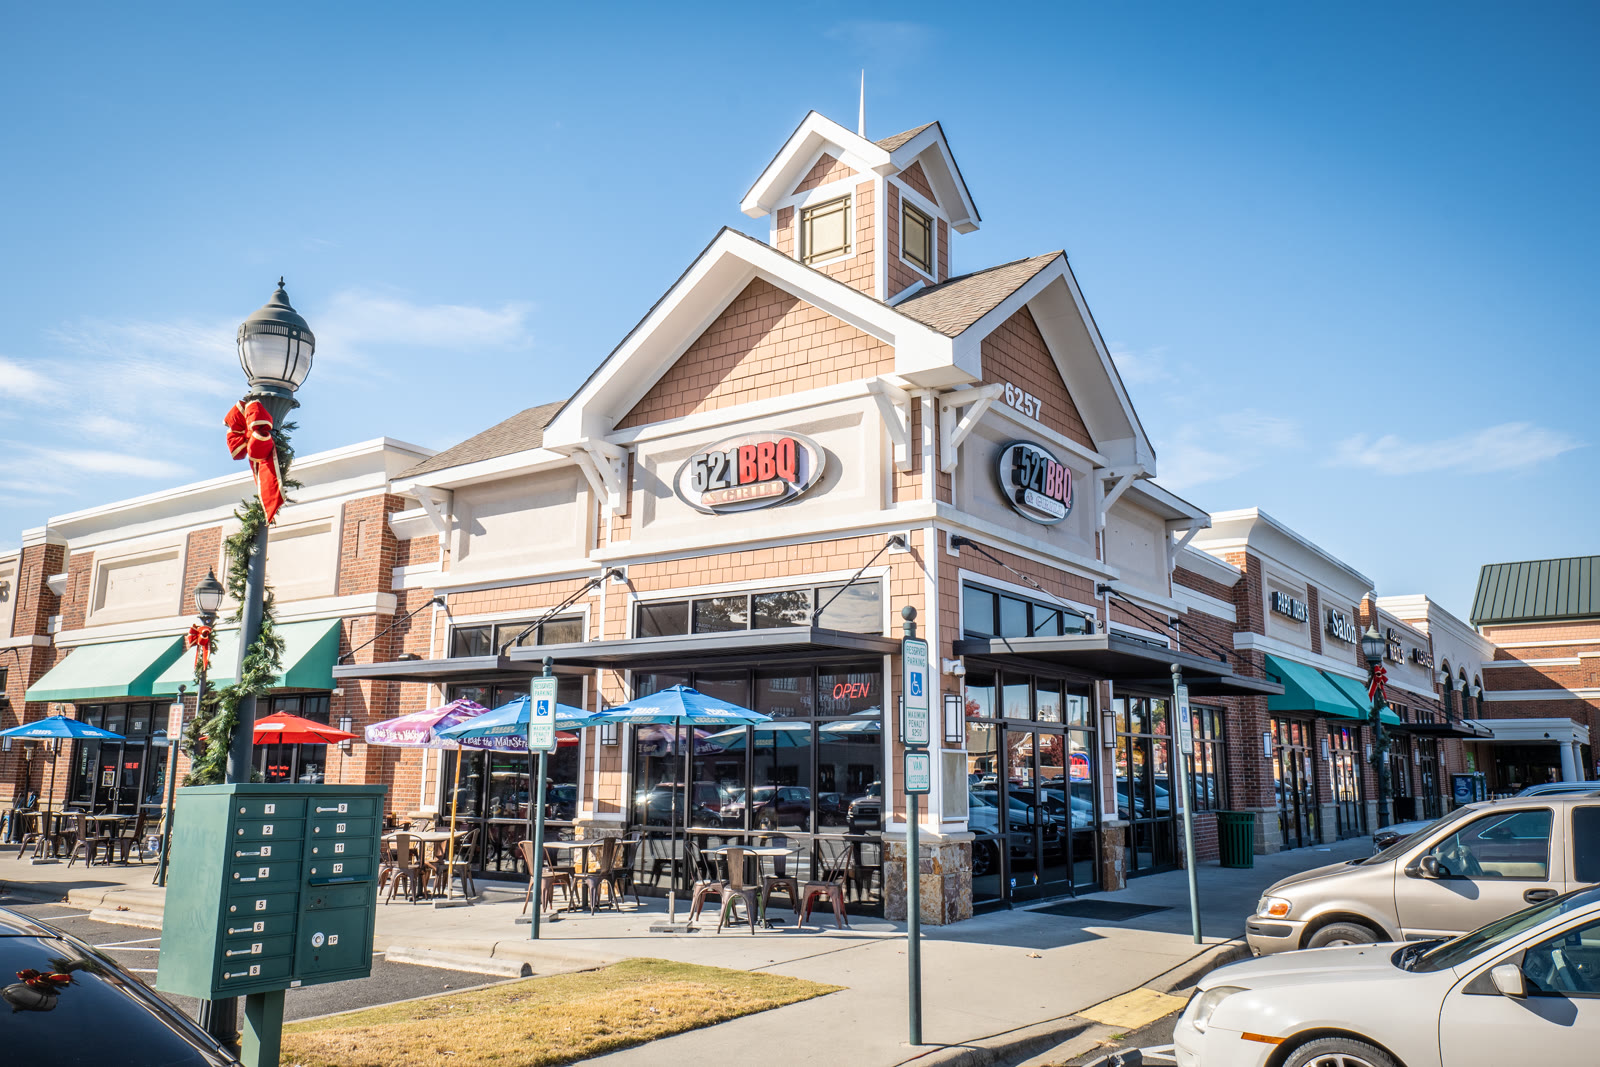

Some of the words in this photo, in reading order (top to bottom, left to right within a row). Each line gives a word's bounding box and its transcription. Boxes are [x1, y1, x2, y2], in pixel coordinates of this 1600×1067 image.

[1005, 382, 1041, 420] 6257
[722, 482, 781, 501] GRILL
[1277, 591, 1291, 615] PAPA
[1332, 609, 1357, 645] Salon
[906, 645, 926, 656] RESERVED
[907, 656, 926, 667] PARKING
[833, 682, 870, 699] OPEN
[907, 710, 926, 720] MAXIMUM
[908, 719, 926, 728] PENALTY
[482, 737, 493, 747] the
[913, 761, 923, 771] VAN
[908, 774, 928, 784] ACCESSIBLE
